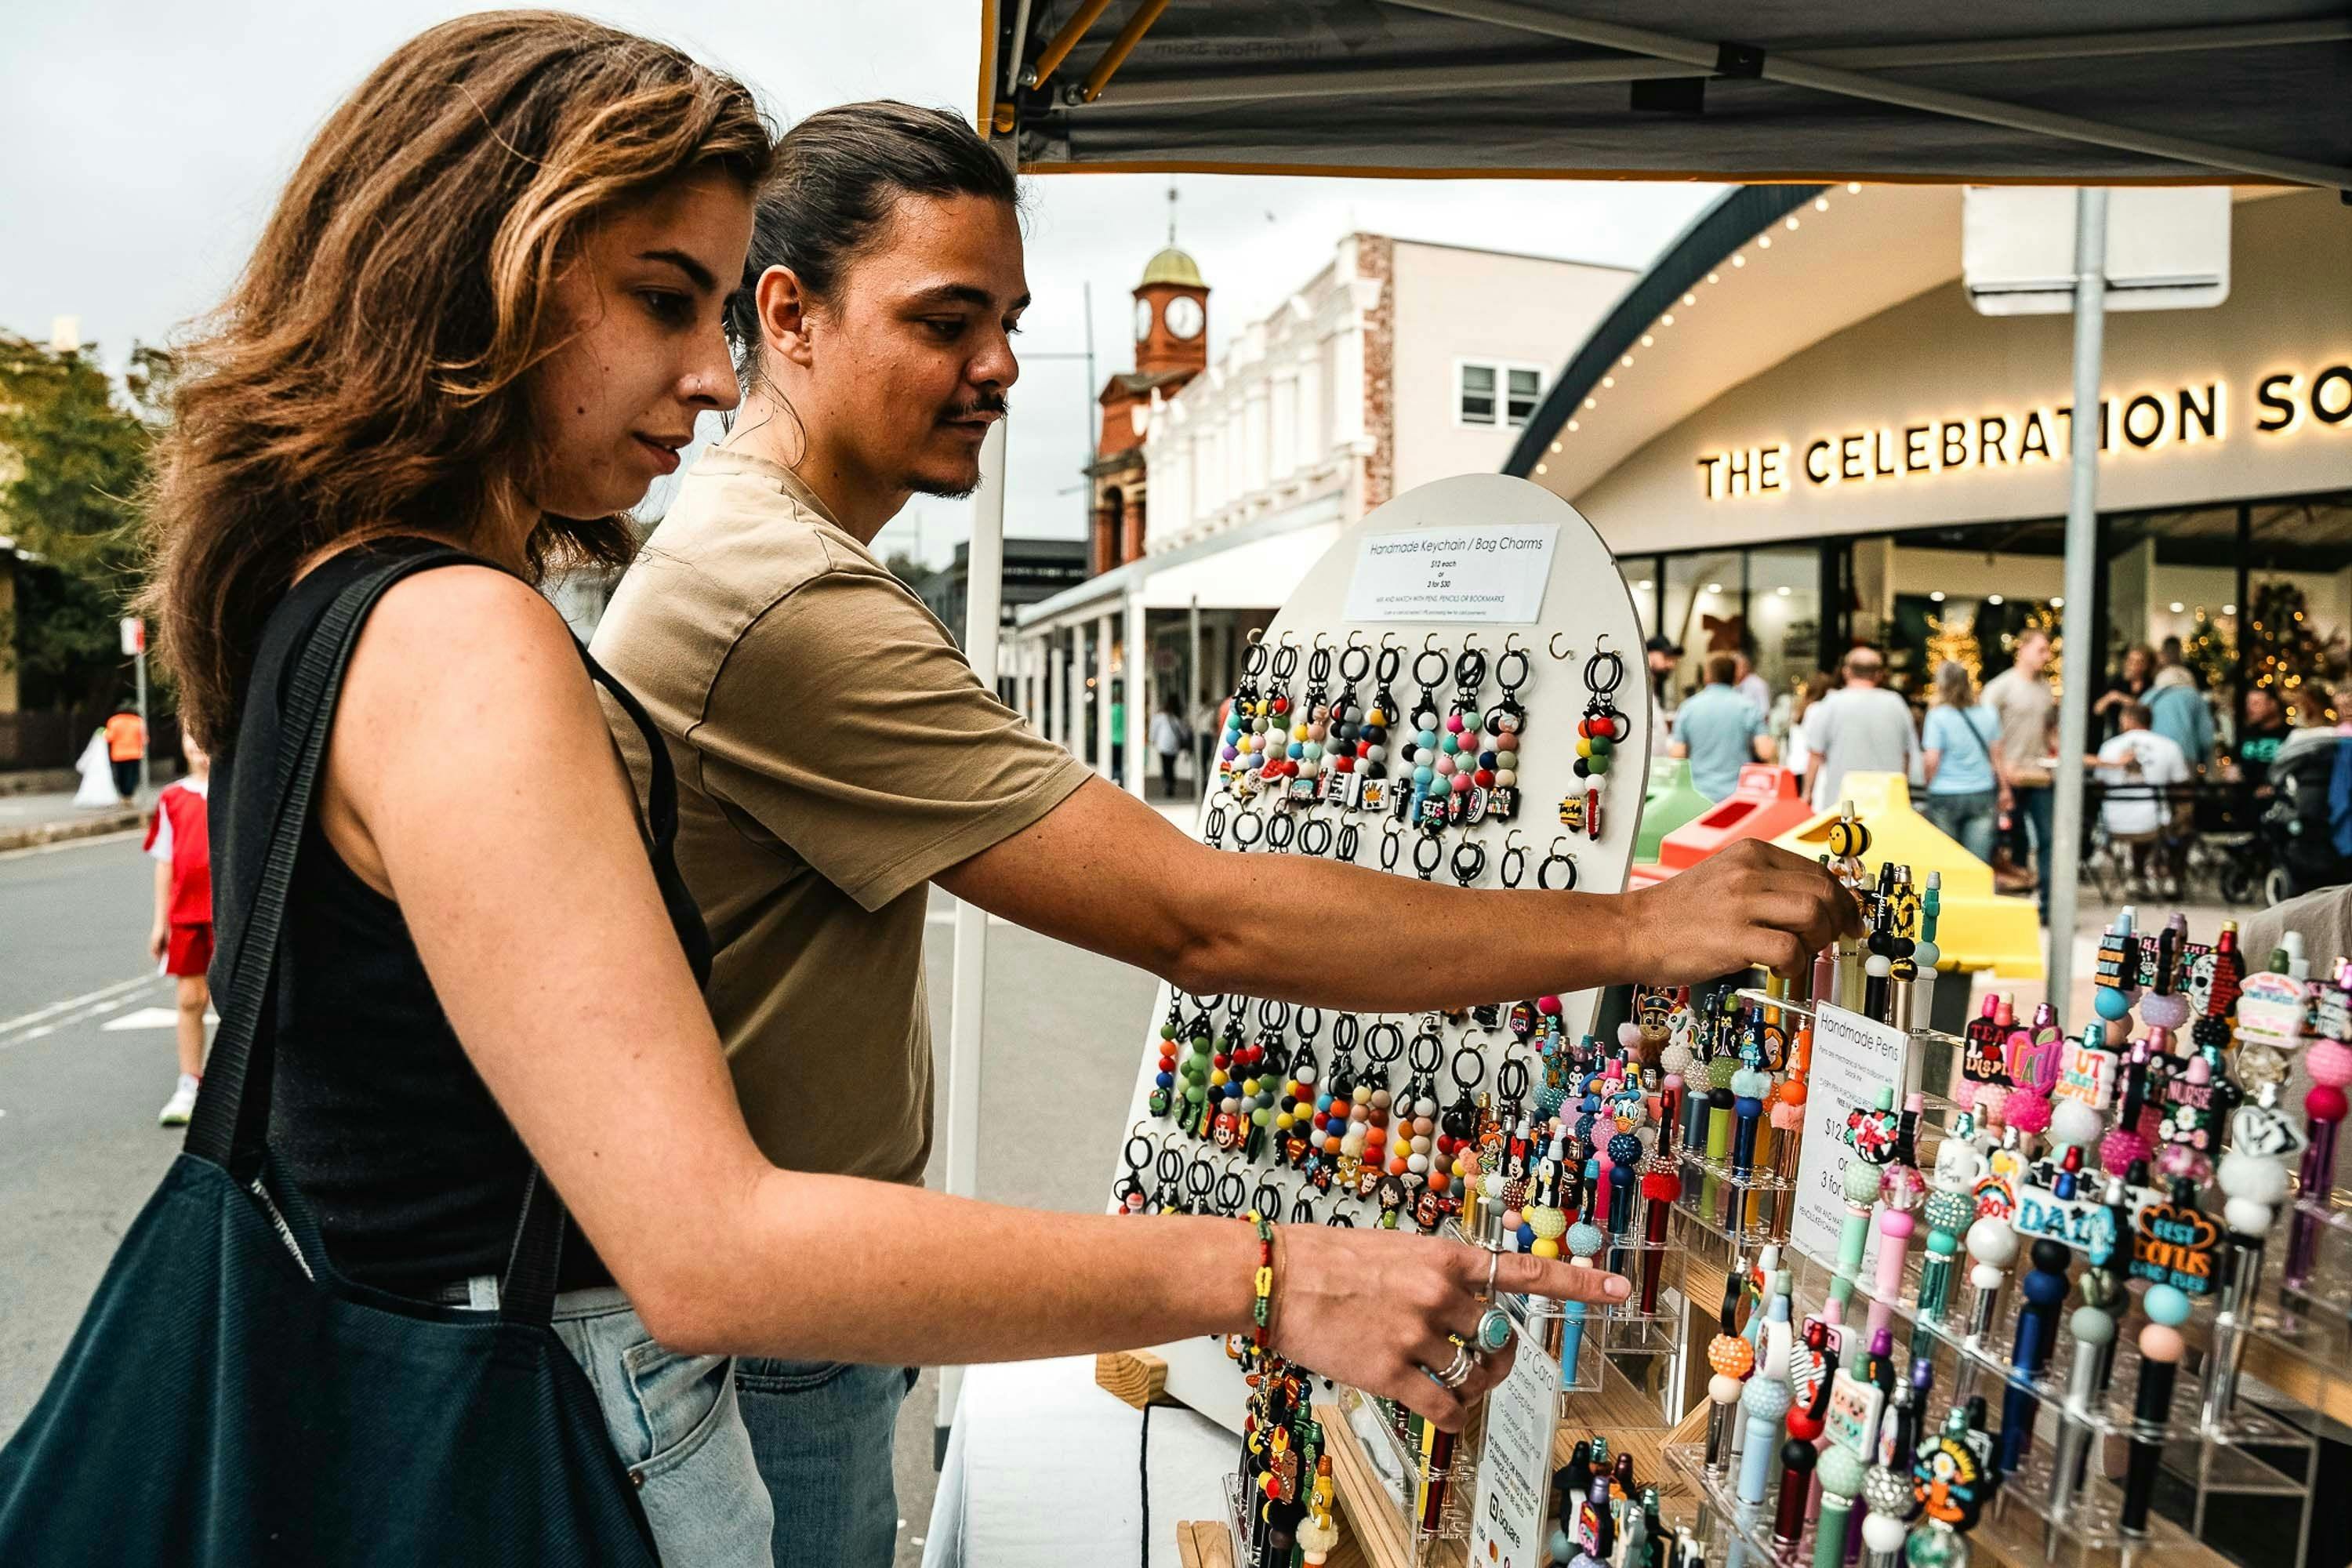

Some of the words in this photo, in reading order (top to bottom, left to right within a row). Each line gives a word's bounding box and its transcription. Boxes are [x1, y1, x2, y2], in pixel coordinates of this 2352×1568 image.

[1698, 445, 1781, 499] THE
[1370, 539, 1419, 554] Handmade
[1421, 537, 1466, 554] Keychain
[1468, 538, 1474, 550] /
[1475, 537, 1497, 553] Bag
[1499, 536, 1543, 550] Charms
[1821, 1013, 1873, 1049] Handmade
[1875, 1036, 1898, 1061] Pens
[1845, 1069, 1856, 1079] black
[1825, 1118, 1841, 1141] $12
[1838, 1158, 1848, 1172] or
[1821, 1171, 1827, 1188] 3
[1829, 1175, 1842, 1196] for
[1823, 1210, 1831, 1221] AND
[1513, 1364, 1537, 1398] ayments
[1523, 1345, 1532, 1364] or
[1533, 1352, 1555, 1392] Card
[1490, 1450, 1504, 1475] CHANGE
[1509, 1462, 1515, 1474] OR
[1499, 1508, 1520, 1548] Square
